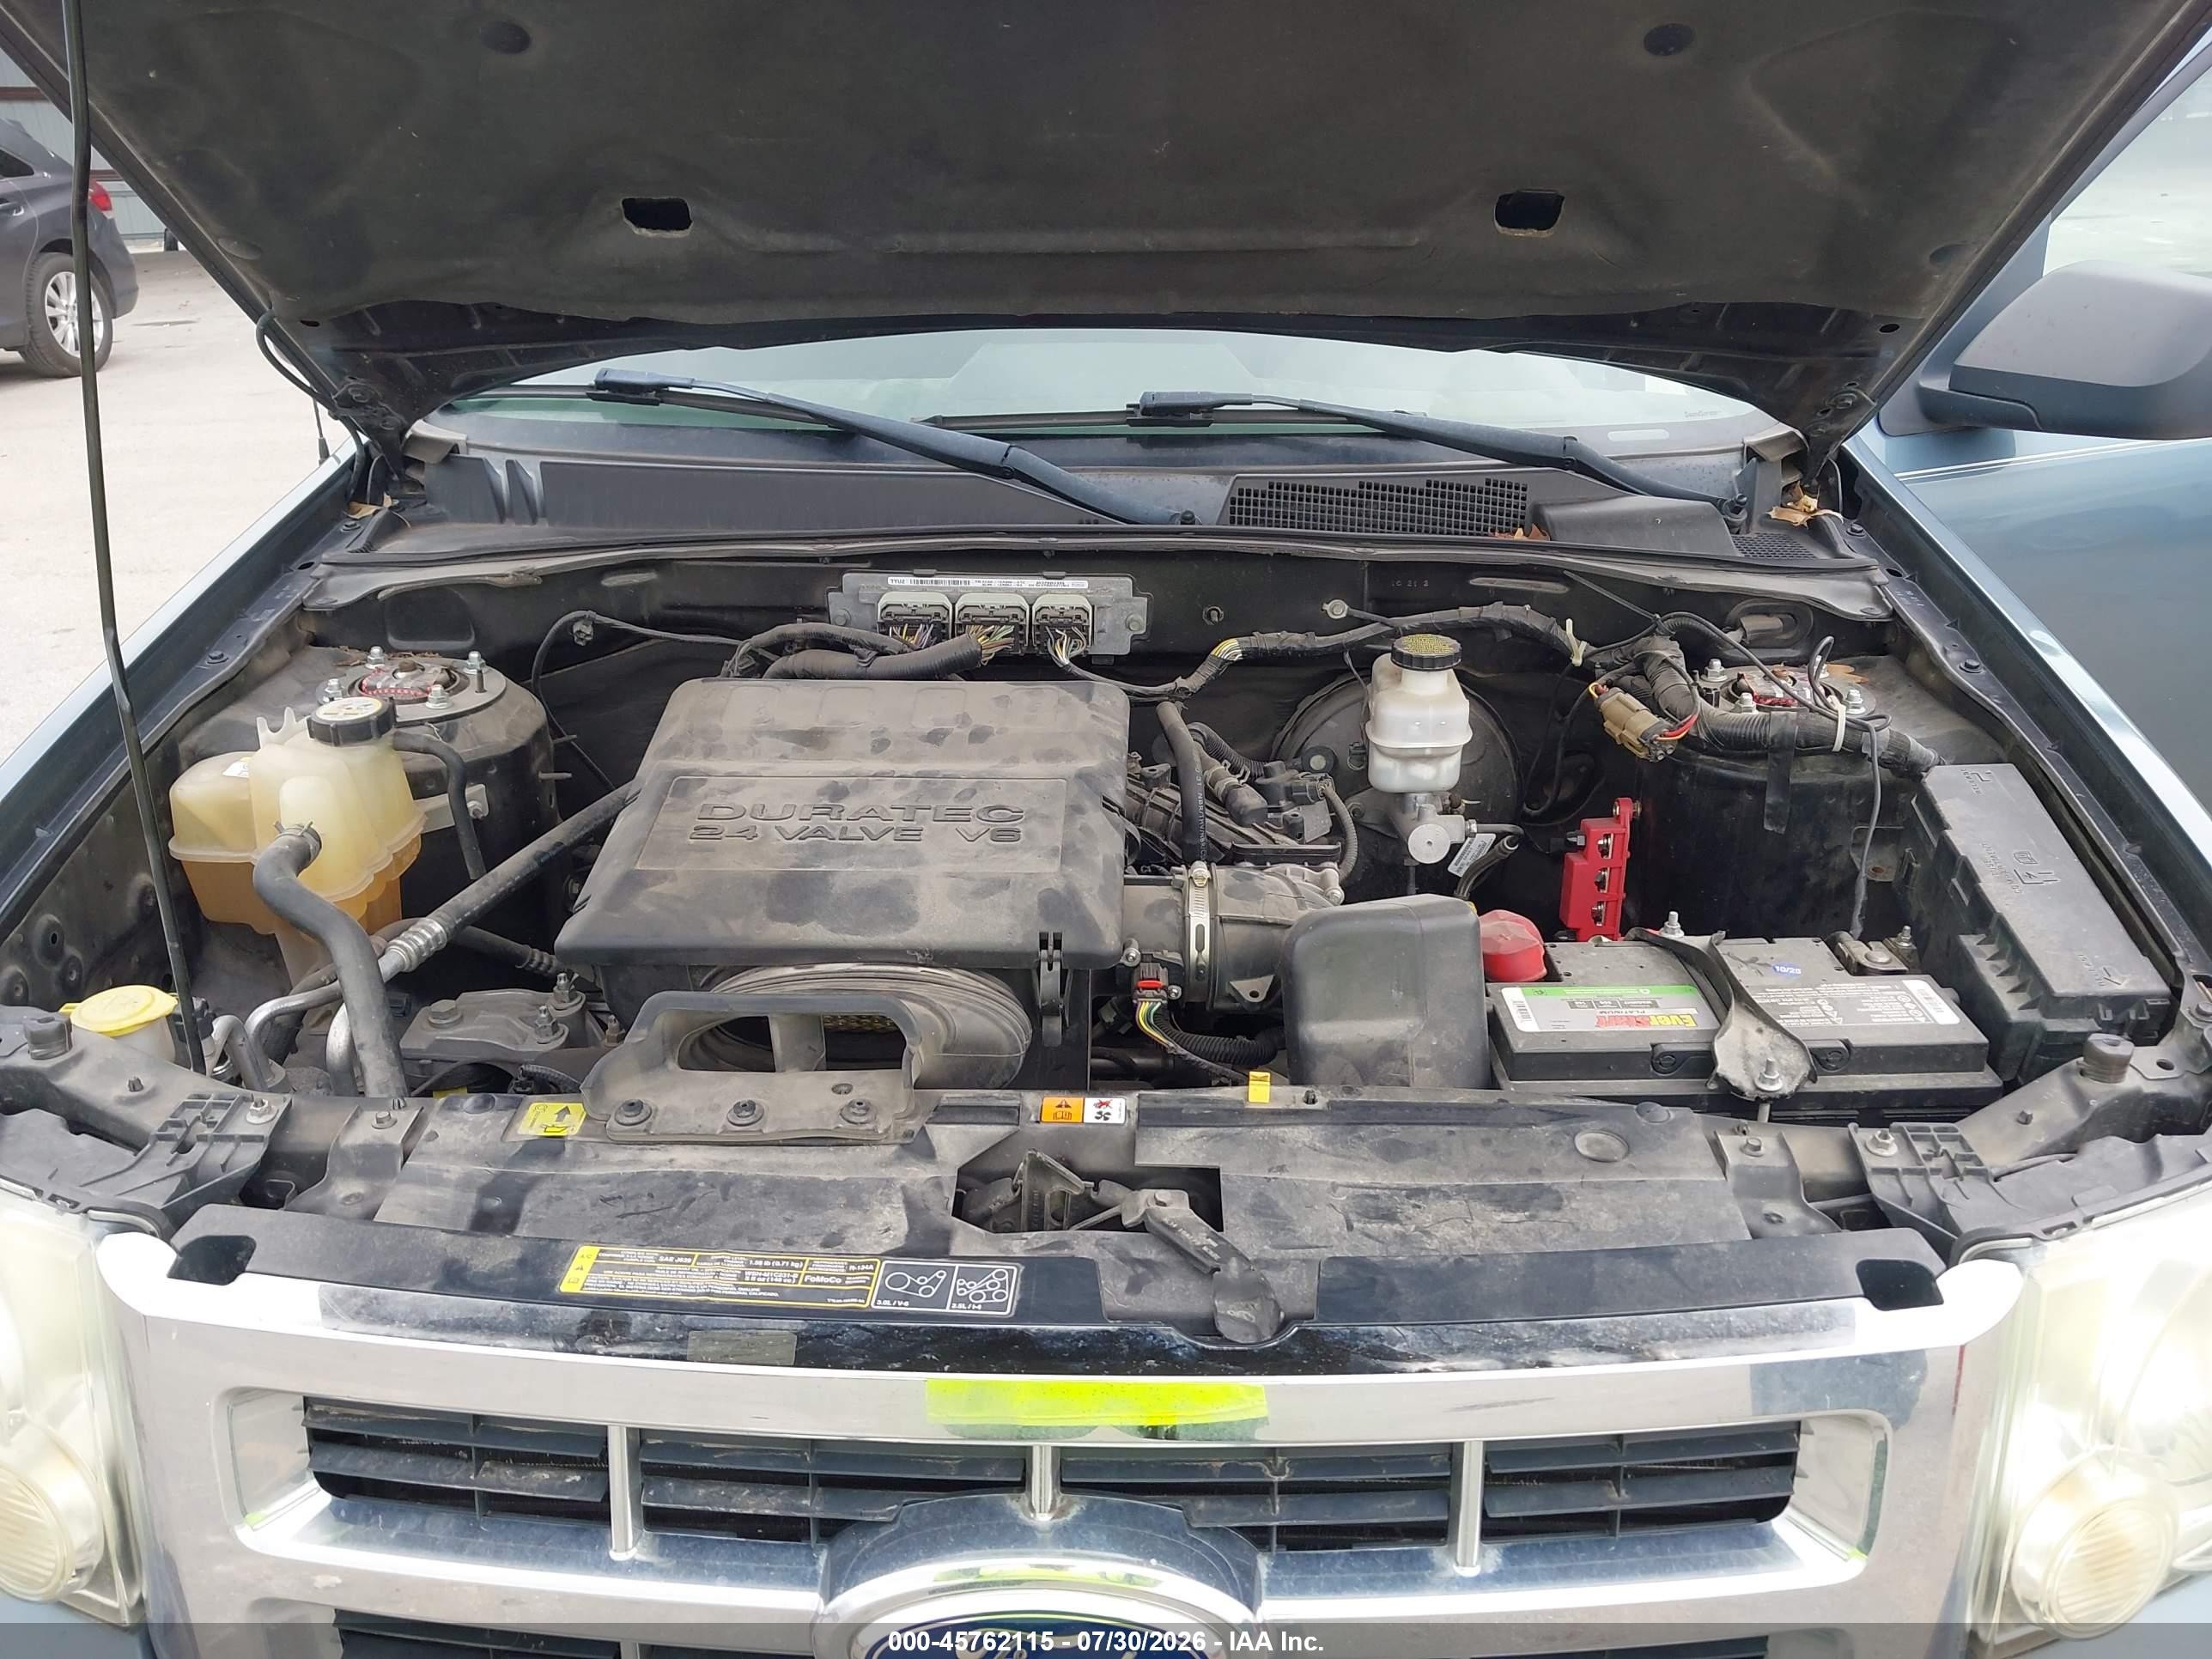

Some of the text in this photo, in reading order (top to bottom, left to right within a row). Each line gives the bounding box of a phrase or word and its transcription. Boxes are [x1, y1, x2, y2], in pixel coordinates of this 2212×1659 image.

[696, 803, 1025, 823] DURATEC
[689, 825, 1023, 842] 24 VALVE V6
[1596, 1014, 1698, 1028] EverStart
[804, 1274, 842, 1285] FoMoCo
